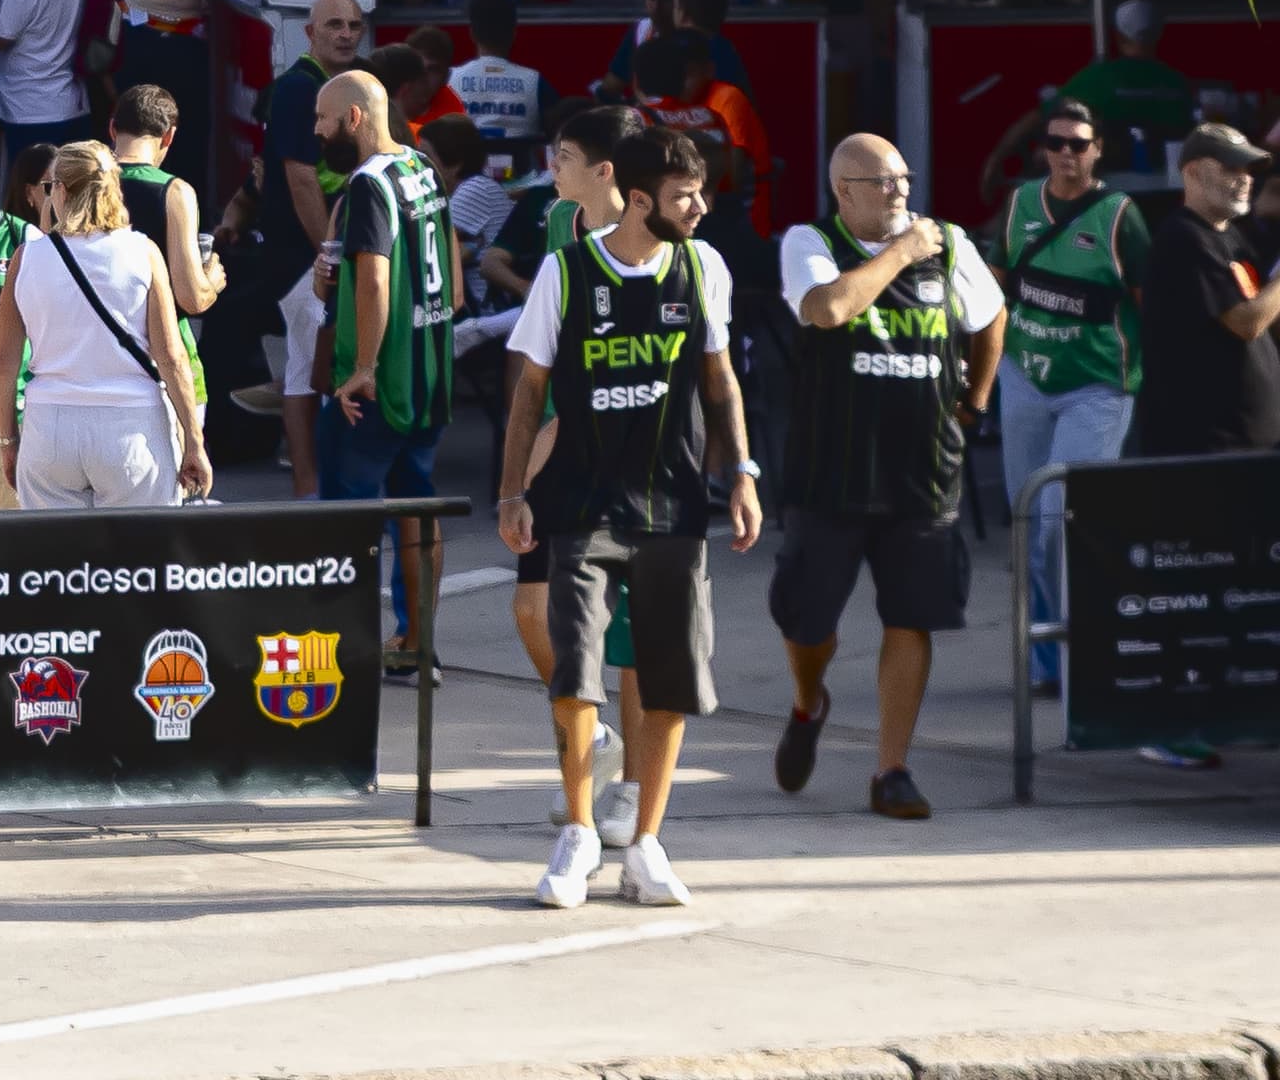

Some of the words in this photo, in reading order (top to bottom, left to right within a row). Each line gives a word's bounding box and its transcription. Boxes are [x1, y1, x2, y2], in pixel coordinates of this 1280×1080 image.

[20, 562, 156, 595] endesa
[165, 557, 356, 592] Badalona'26
[281, 672, 316, 683] FCB
